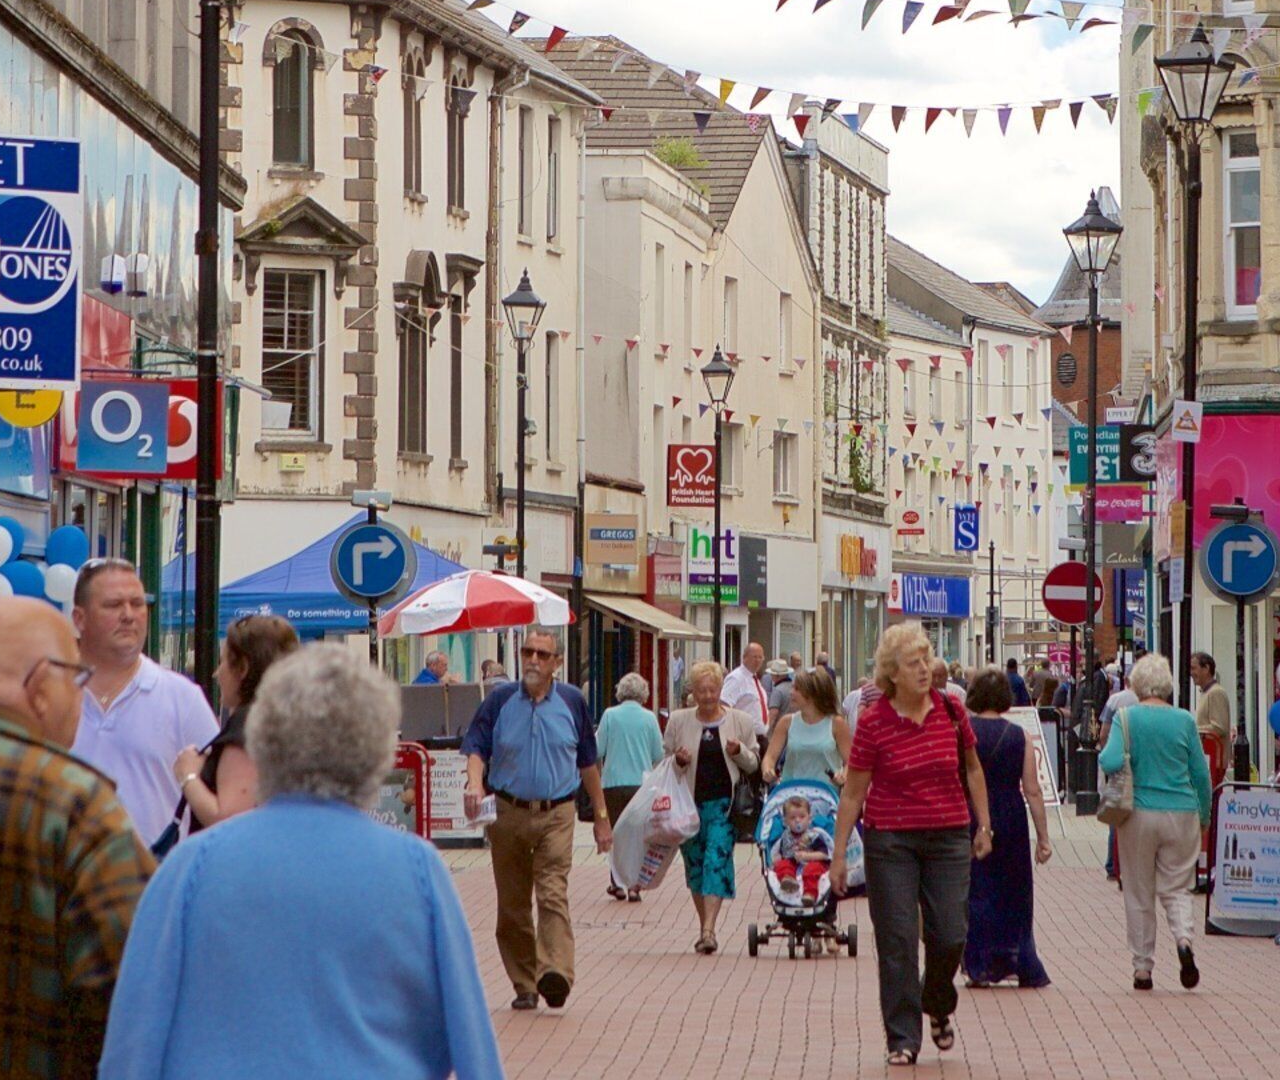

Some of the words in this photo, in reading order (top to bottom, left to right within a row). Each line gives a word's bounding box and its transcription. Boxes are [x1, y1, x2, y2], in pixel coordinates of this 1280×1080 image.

[671, 495, 715, 504] Foundation
[600, 529, 634, 539] GREGGS
[958, 521, 977, 549] S
[903, 575, 948, 614] WHSmith
[287, 609, 301, 618] Do
[303, 608, 351, 620] something
